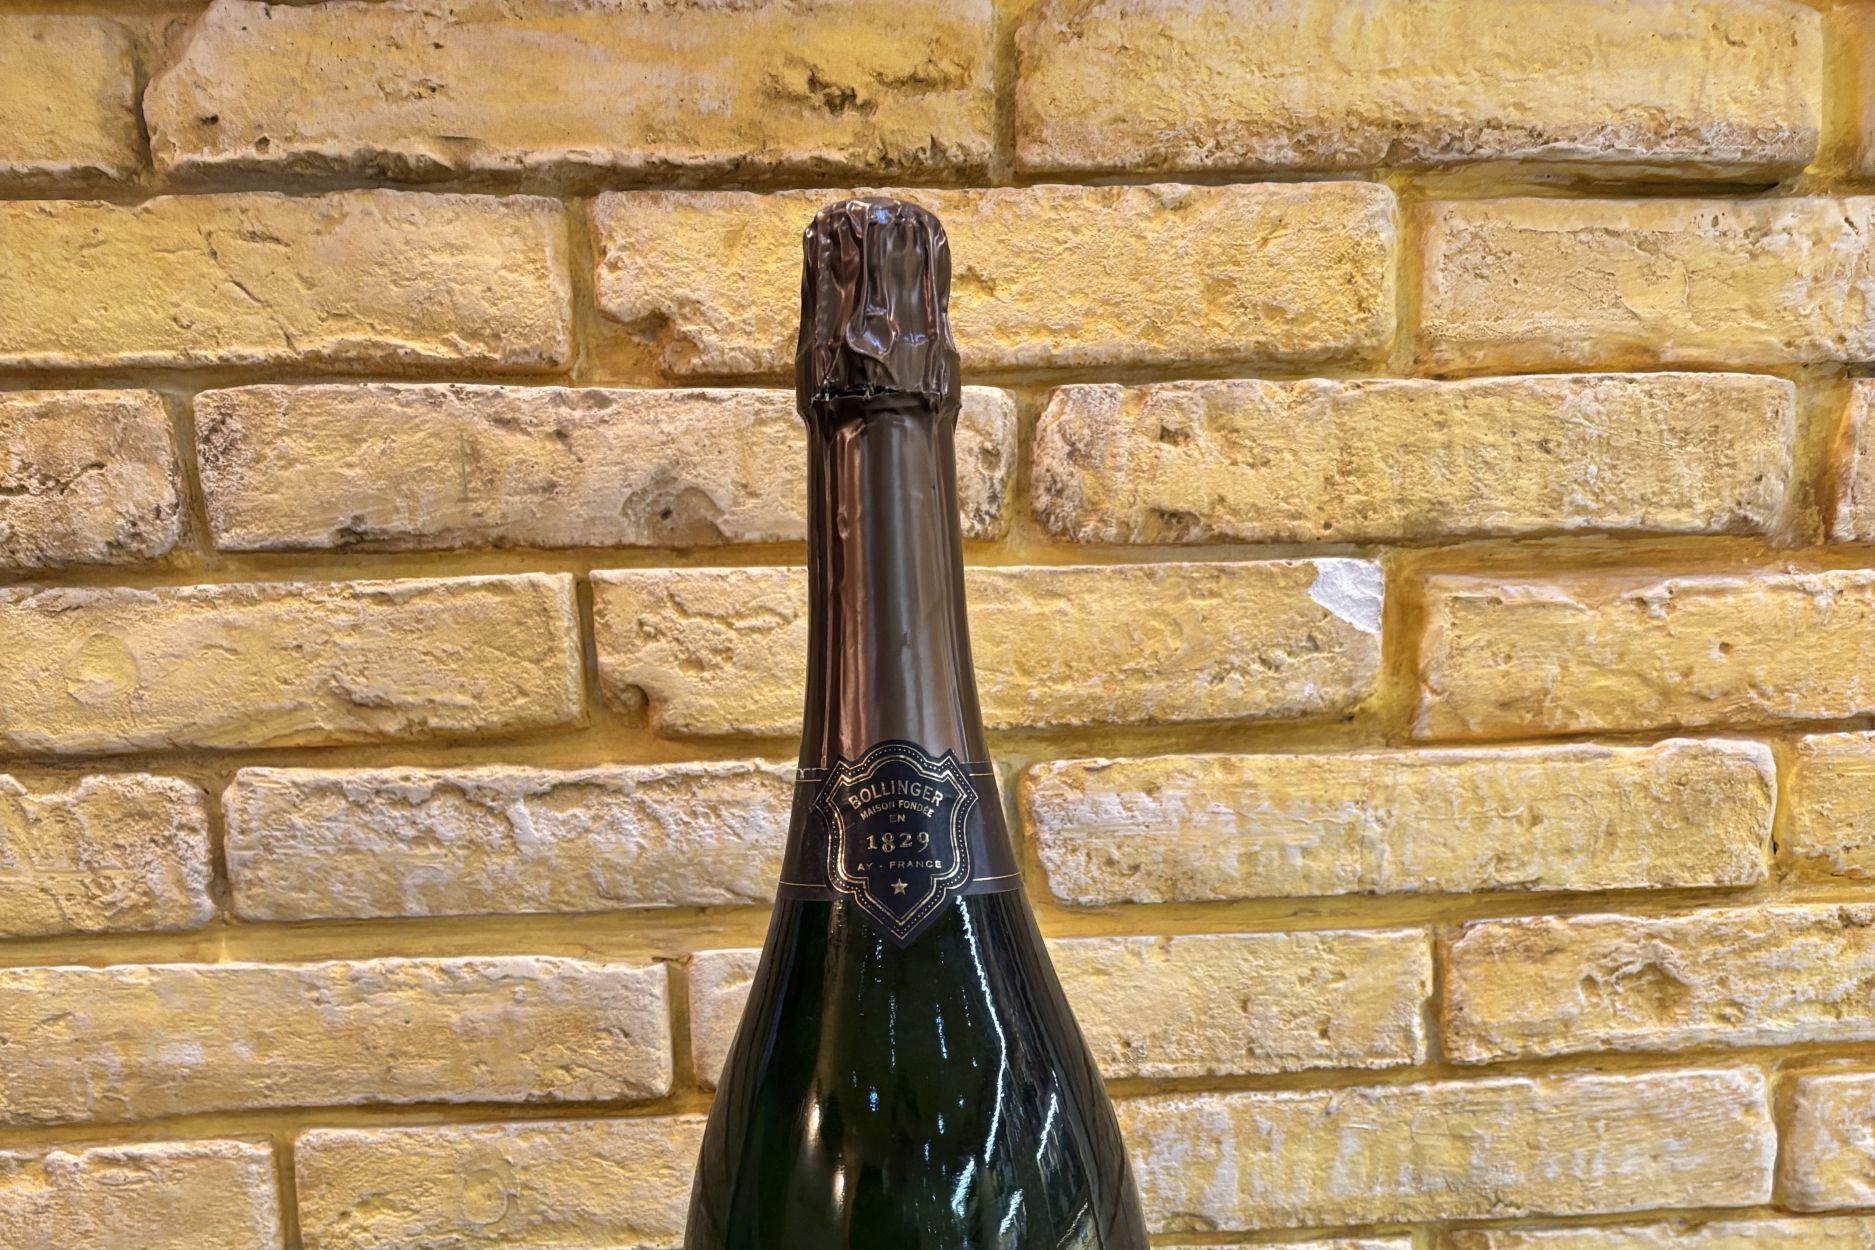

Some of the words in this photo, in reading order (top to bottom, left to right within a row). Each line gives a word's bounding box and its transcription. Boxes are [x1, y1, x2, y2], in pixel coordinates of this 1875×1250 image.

[848, 780, 943, 810] BOLLINGER
[859, 801, 896, 821] MAISON
[898, 799, 935, 818] FONDÉE
[889, 814, 906, 823] EN
[866, 831, 930, 854] 1829
[889, 860, 942, 869] FRANCE
